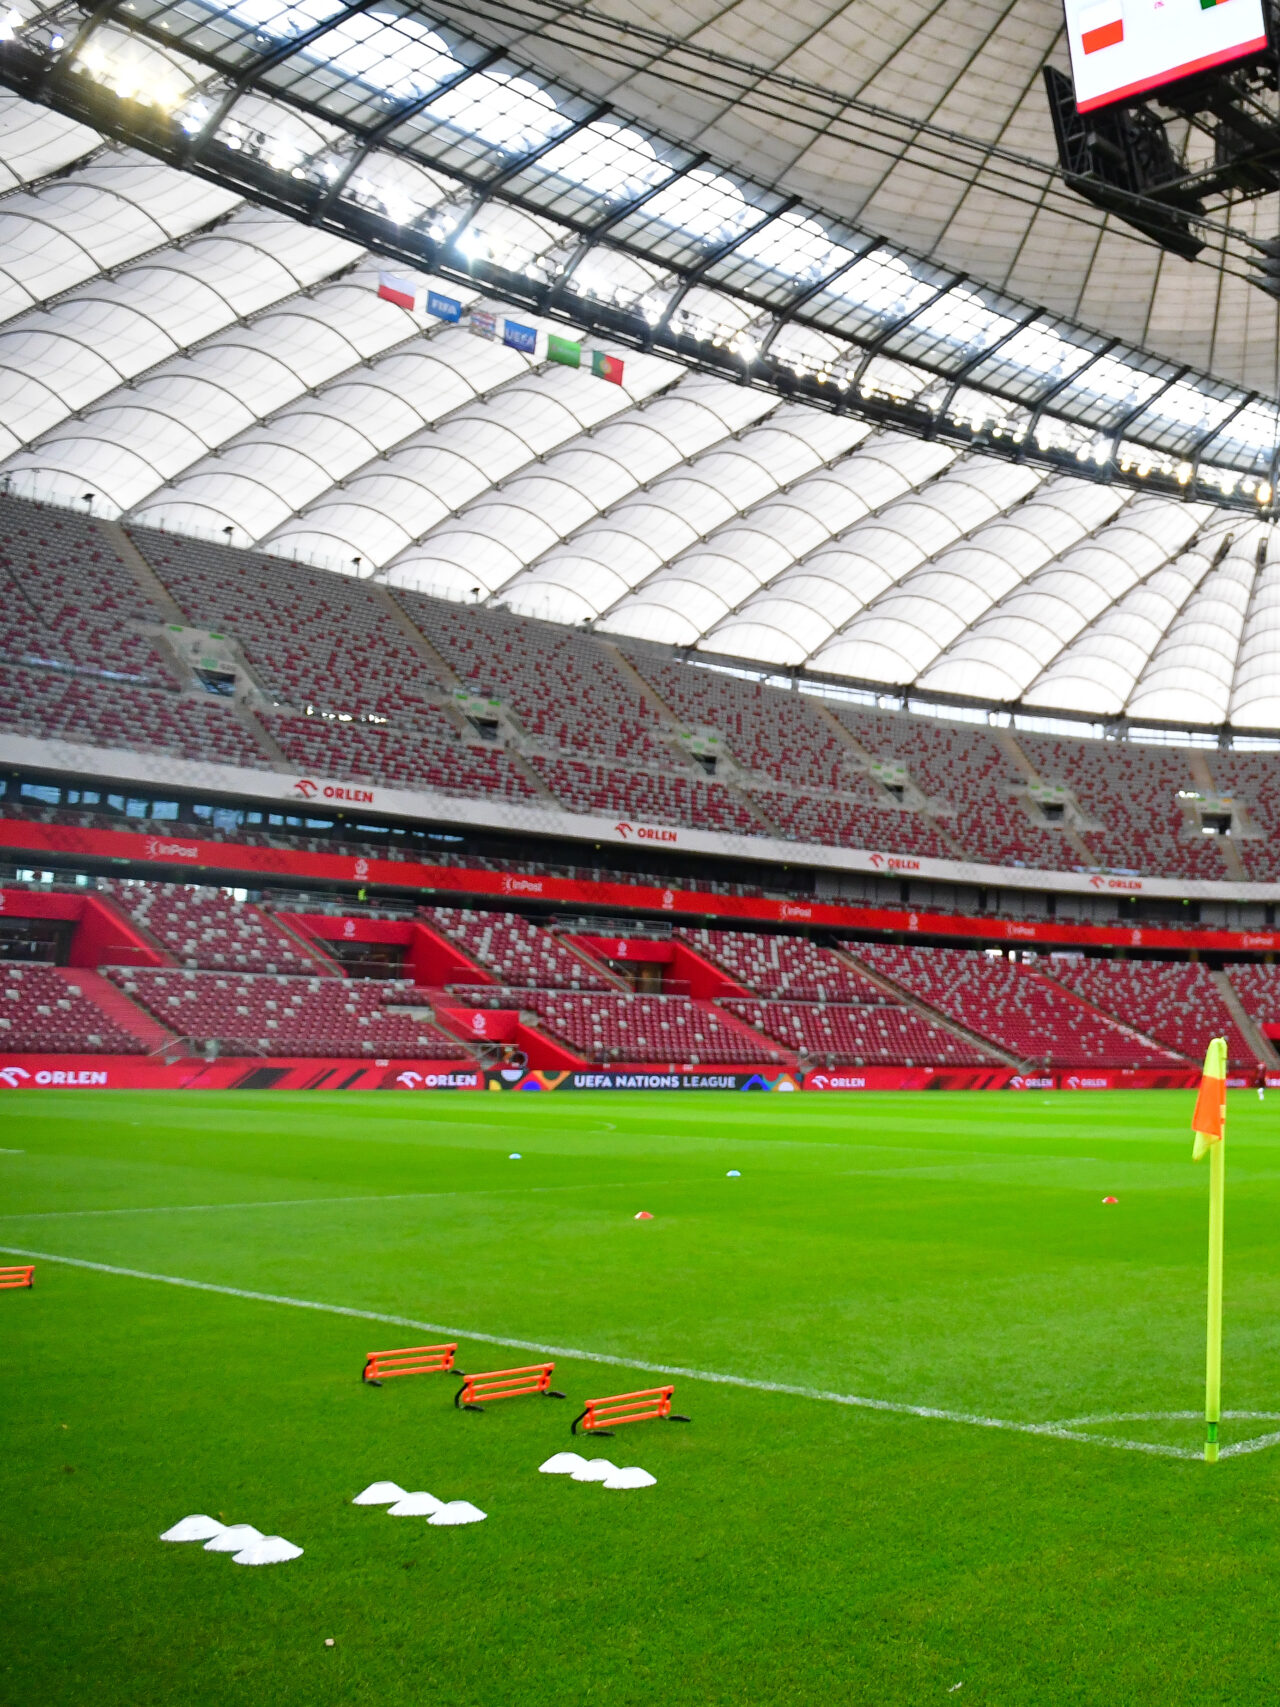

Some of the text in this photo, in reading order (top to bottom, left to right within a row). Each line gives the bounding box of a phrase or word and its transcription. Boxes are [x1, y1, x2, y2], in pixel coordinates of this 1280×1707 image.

[431, 298, 458, 316] FIFA
[506, 327, 534, 346] UEFA
[323, 785, 374, 804] ORLEN
[637, 827, 678, 843] ORLEN
[159, 843, 198, 858] InPost
[887, 857, 920, 871] ORLEN
[512, 879, 543, 893] InPost
[1108, 880, 1142, 890] ORLEN
[34, 1070, 108, 1085] ORLEN
[424, 1074, 478, 1087] ORLEN
[574, 1074, 737, 1089] UEFA NATIONS LEAGUE
[830, 1077, 866, 1088] ORLEN
[1025, 1078, 1053, 1088] ORLEN
[1080, 1078, 1107, 1088] ORLEN
